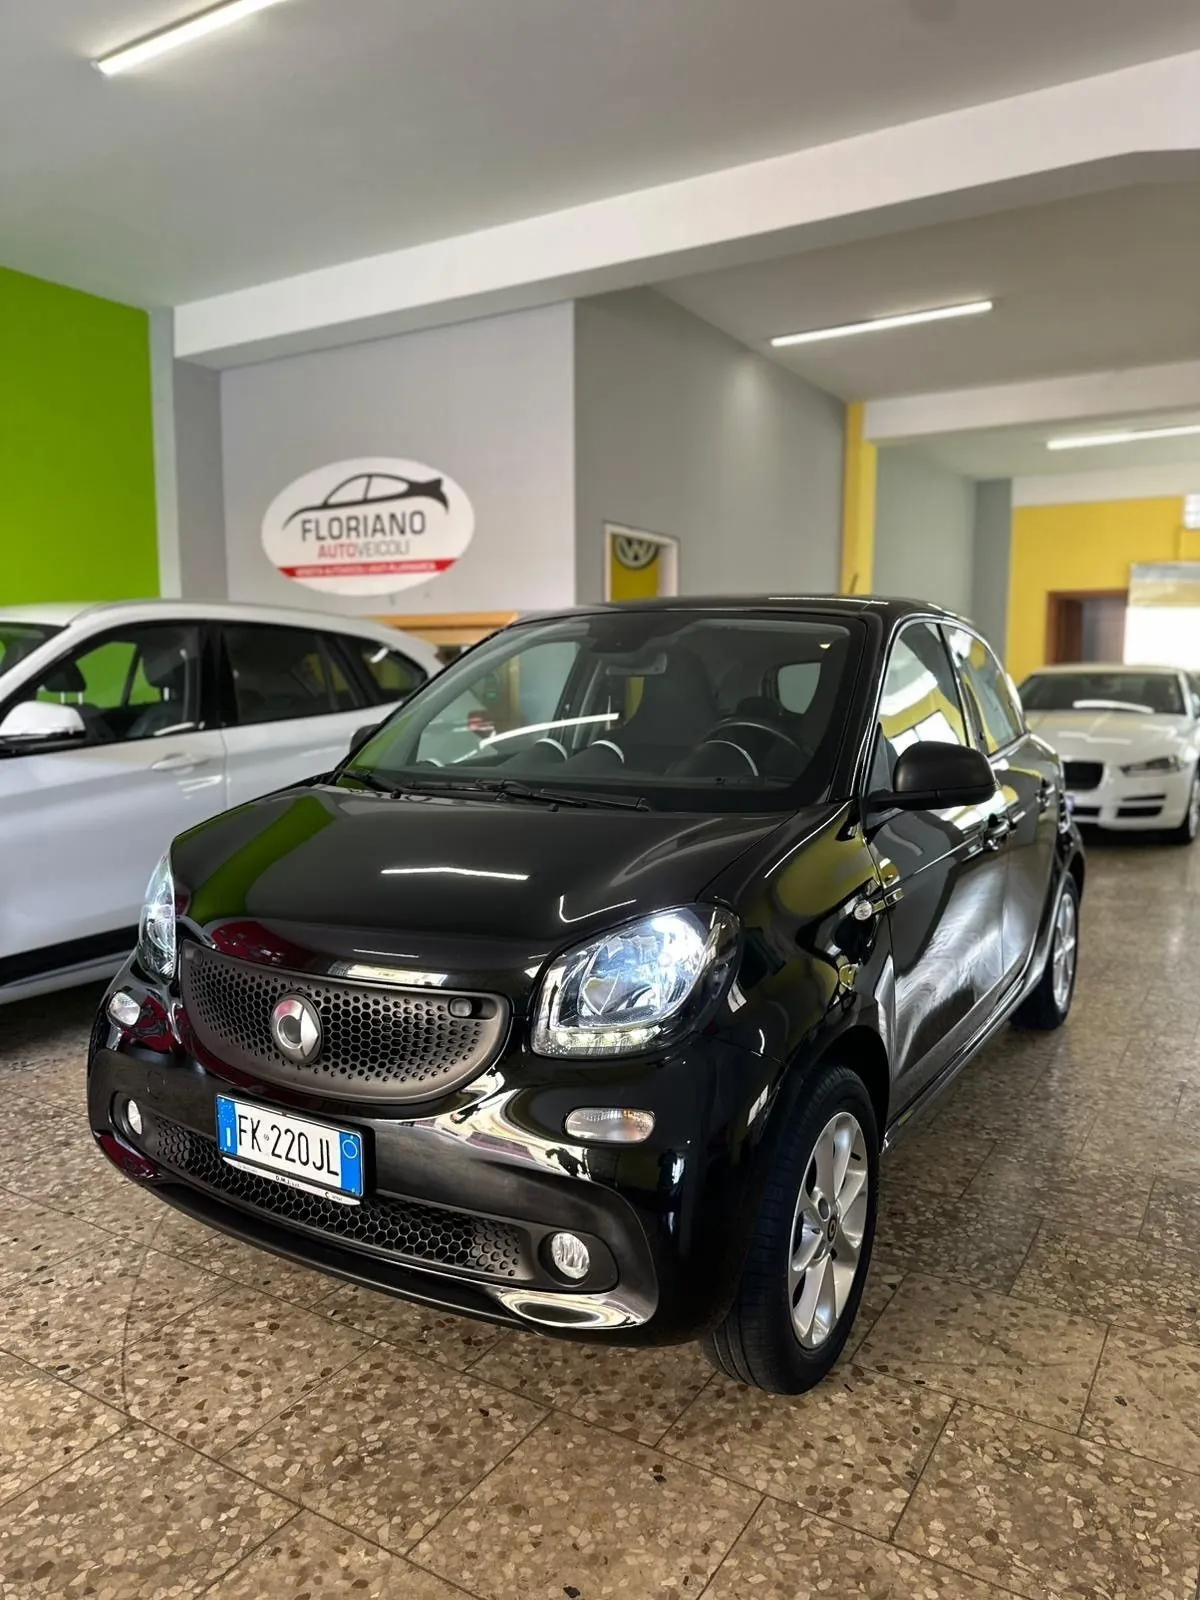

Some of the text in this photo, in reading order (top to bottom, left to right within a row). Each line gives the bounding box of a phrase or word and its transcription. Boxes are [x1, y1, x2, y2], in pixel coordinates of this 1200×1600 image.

[301, 510, 426, 542] FLORIANO
[317, 540, 410, 559] AUTOVEICOLI
[237, 1114, 340, 1177] FK 220JL
